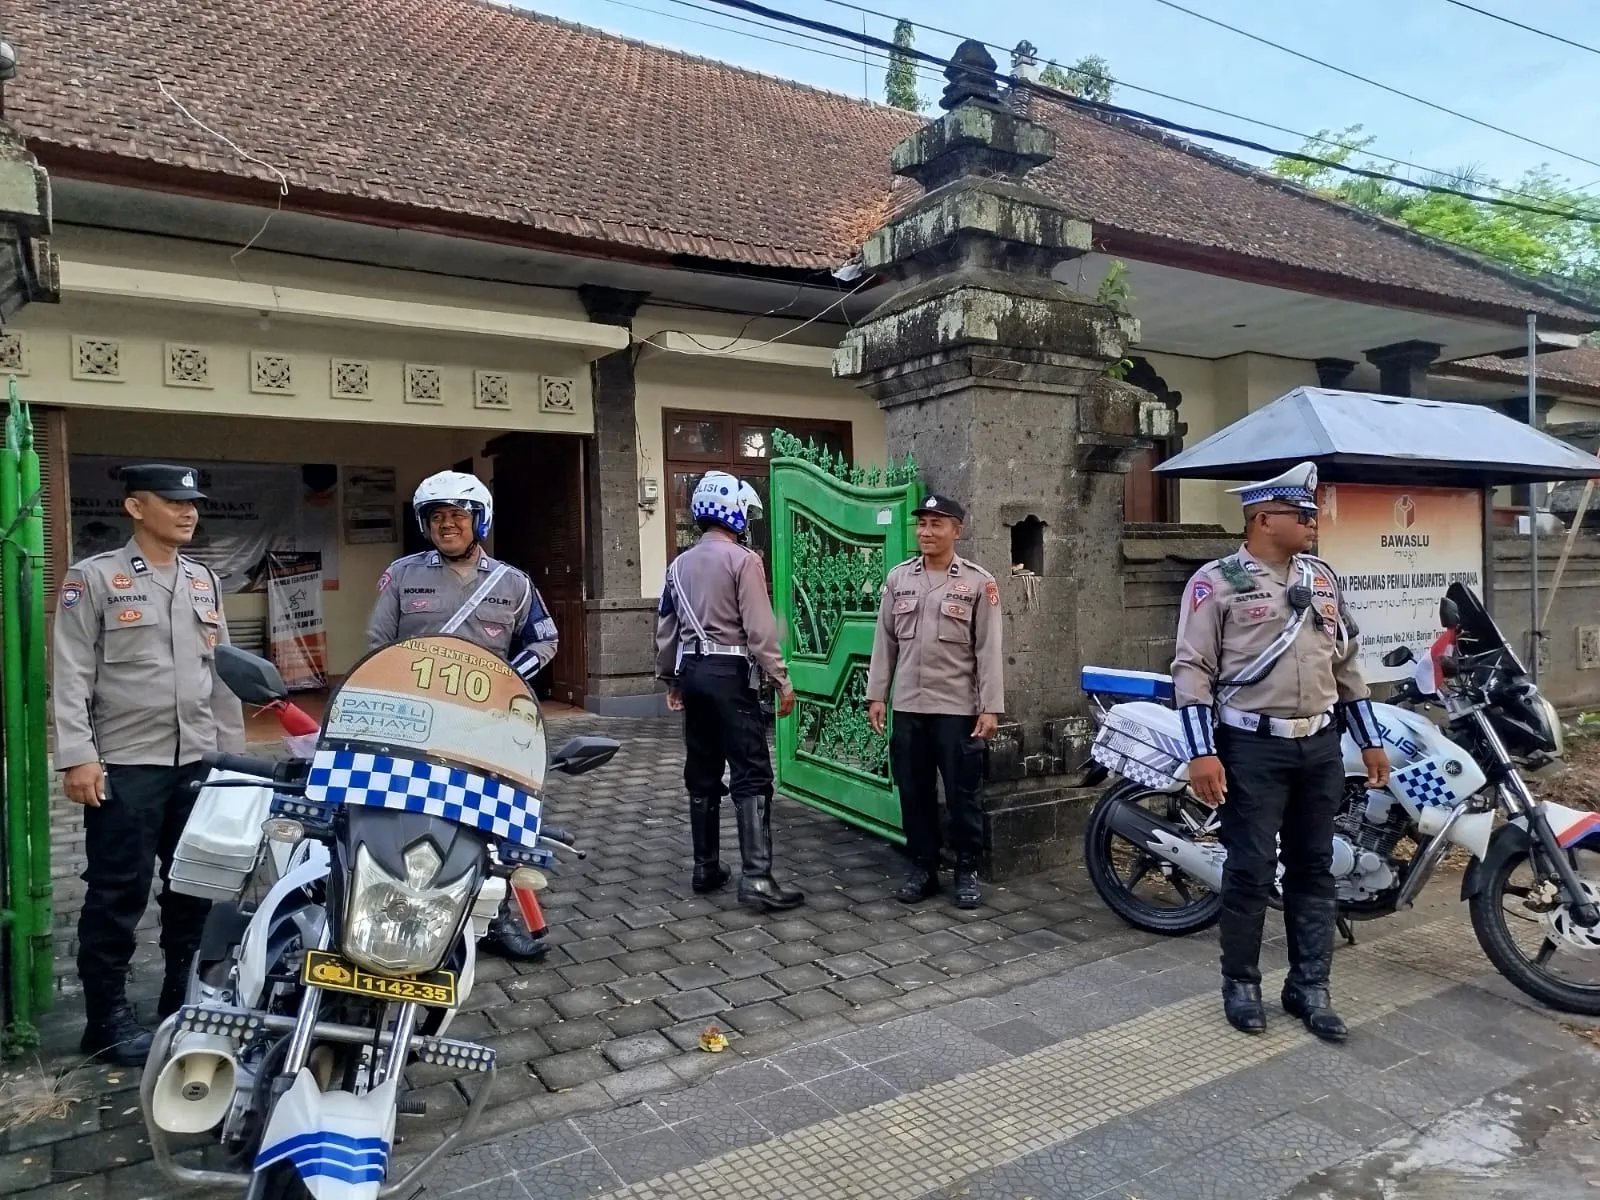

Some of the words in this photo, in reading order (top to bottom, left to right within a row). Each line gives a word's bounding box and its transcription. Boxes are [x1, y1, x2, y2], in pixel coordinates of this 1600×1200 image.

[1381, 535, 1429, 547] BAWASLU
[1349, 574, 1386, 591] PENGAWAS
[1387, 573, 1410, 589] PEMILU
[1411, 572, 1447, 588] KABUPATEN
[946, 593, 972, 603] POLRI
[1362, 634, 1375, 646] Jalan
[395, 640, 427, 652] ALL
[429, 645, 479, 665] CENTER
[480, 658, 513, 677] POLRI
[411, 657, 491, 703] 110
[340, 714, 427, 733] RAHAYU
[362, 977, 447, 1001] 1142-35
